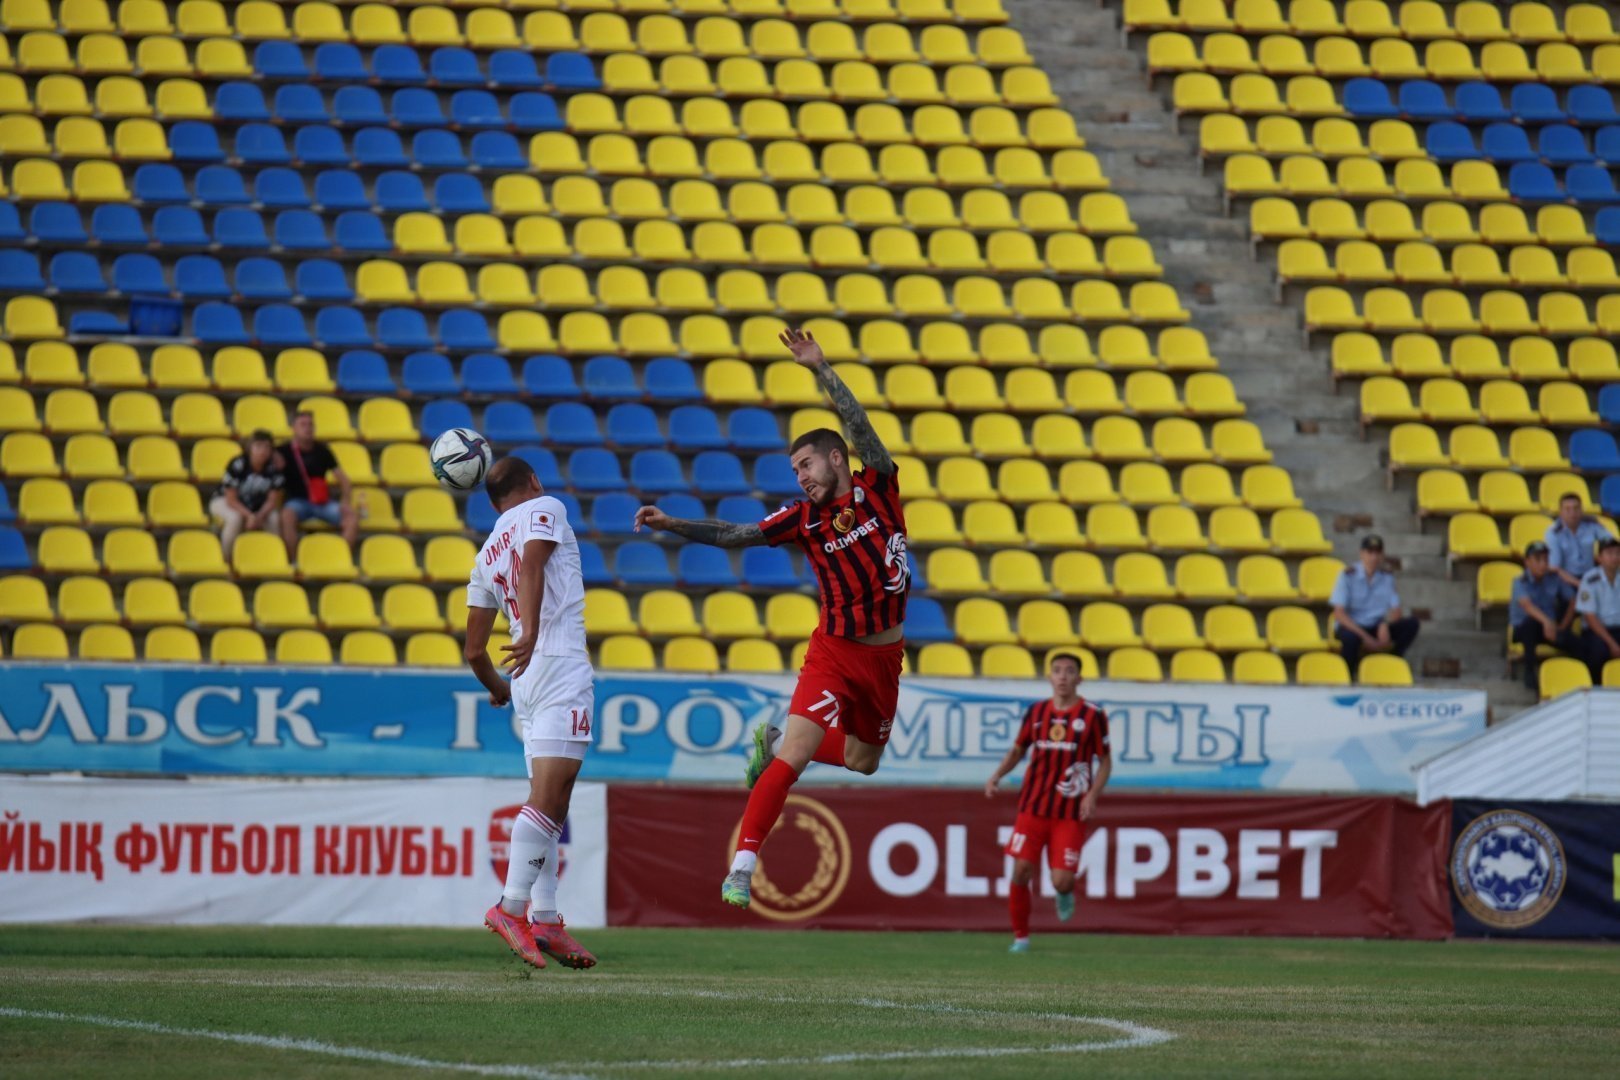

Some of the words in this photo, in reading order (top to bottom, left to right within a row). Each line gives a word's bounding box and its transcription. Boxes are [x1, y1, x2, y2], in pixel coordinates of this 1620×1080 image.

[824, 516, 879, 553] OLIMPBET
[571, 708, 590, 736] 14
[1358, 702, 1378, 718] 10
[1383, 702, 1463, 719] СЕКТОР
[885, 699, 1270, 767] МЕТЫ
[114, 822, 300, 877] ФУТБОЛ
[313, 825, 473, 878] КЛУБЫ
